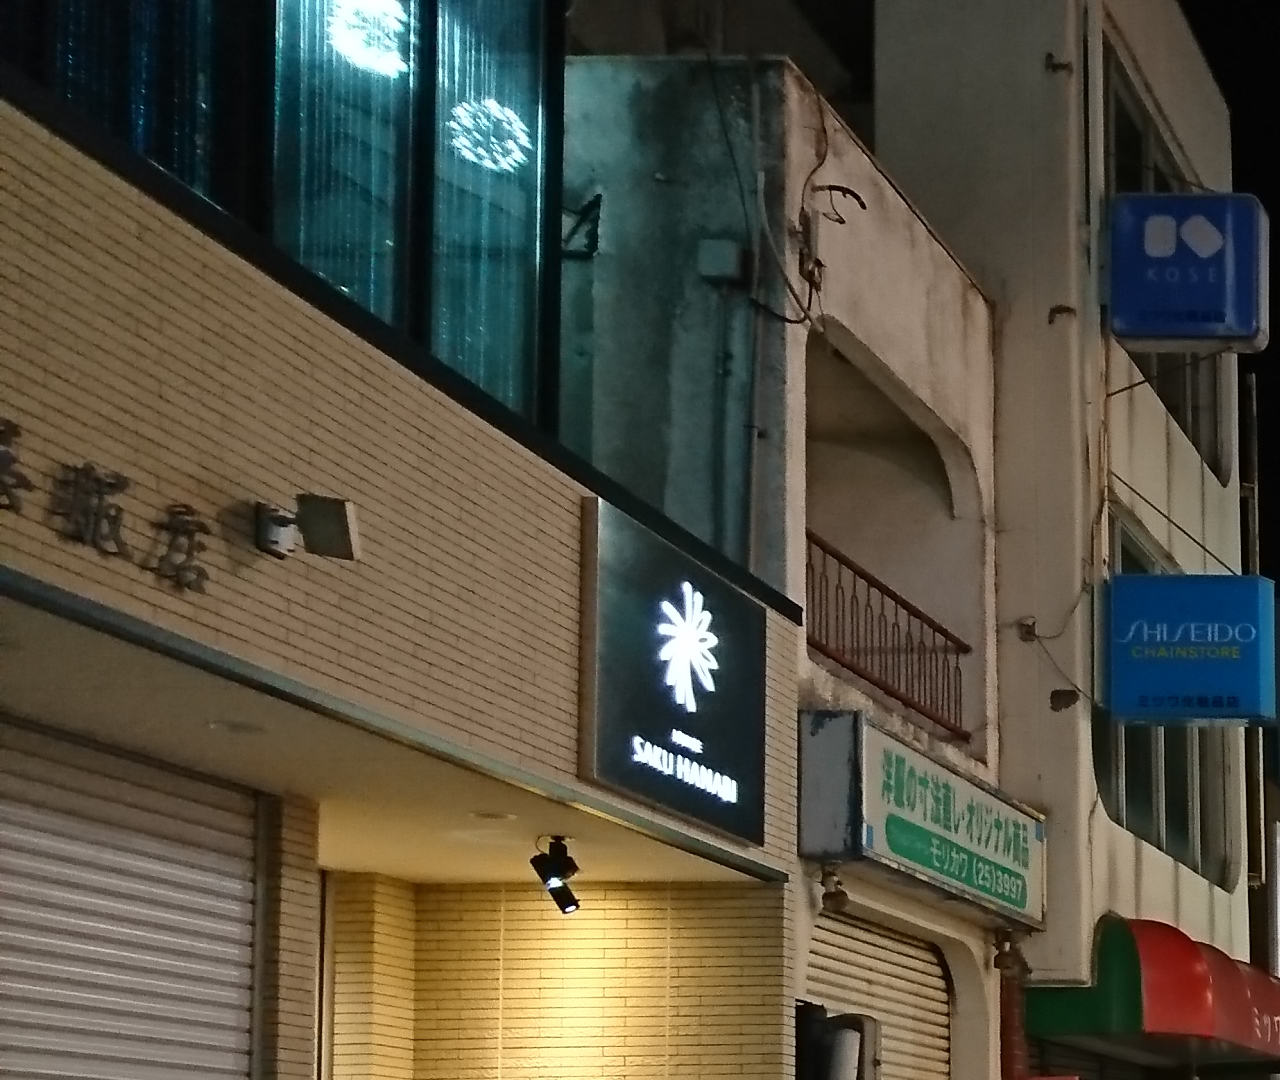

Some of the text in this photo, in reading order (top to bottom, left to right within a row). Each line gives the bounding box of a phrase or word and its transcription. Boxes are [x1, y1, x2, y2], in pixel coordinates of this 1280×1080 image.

[1118, 619, 1257, 642] SHISEIDO
[1131, 646, 1241, 659] CHAINSTORE
[632, 734, 674, 775] SAKU
[930, 837, 1023, 900] モリカワ (25)3997
